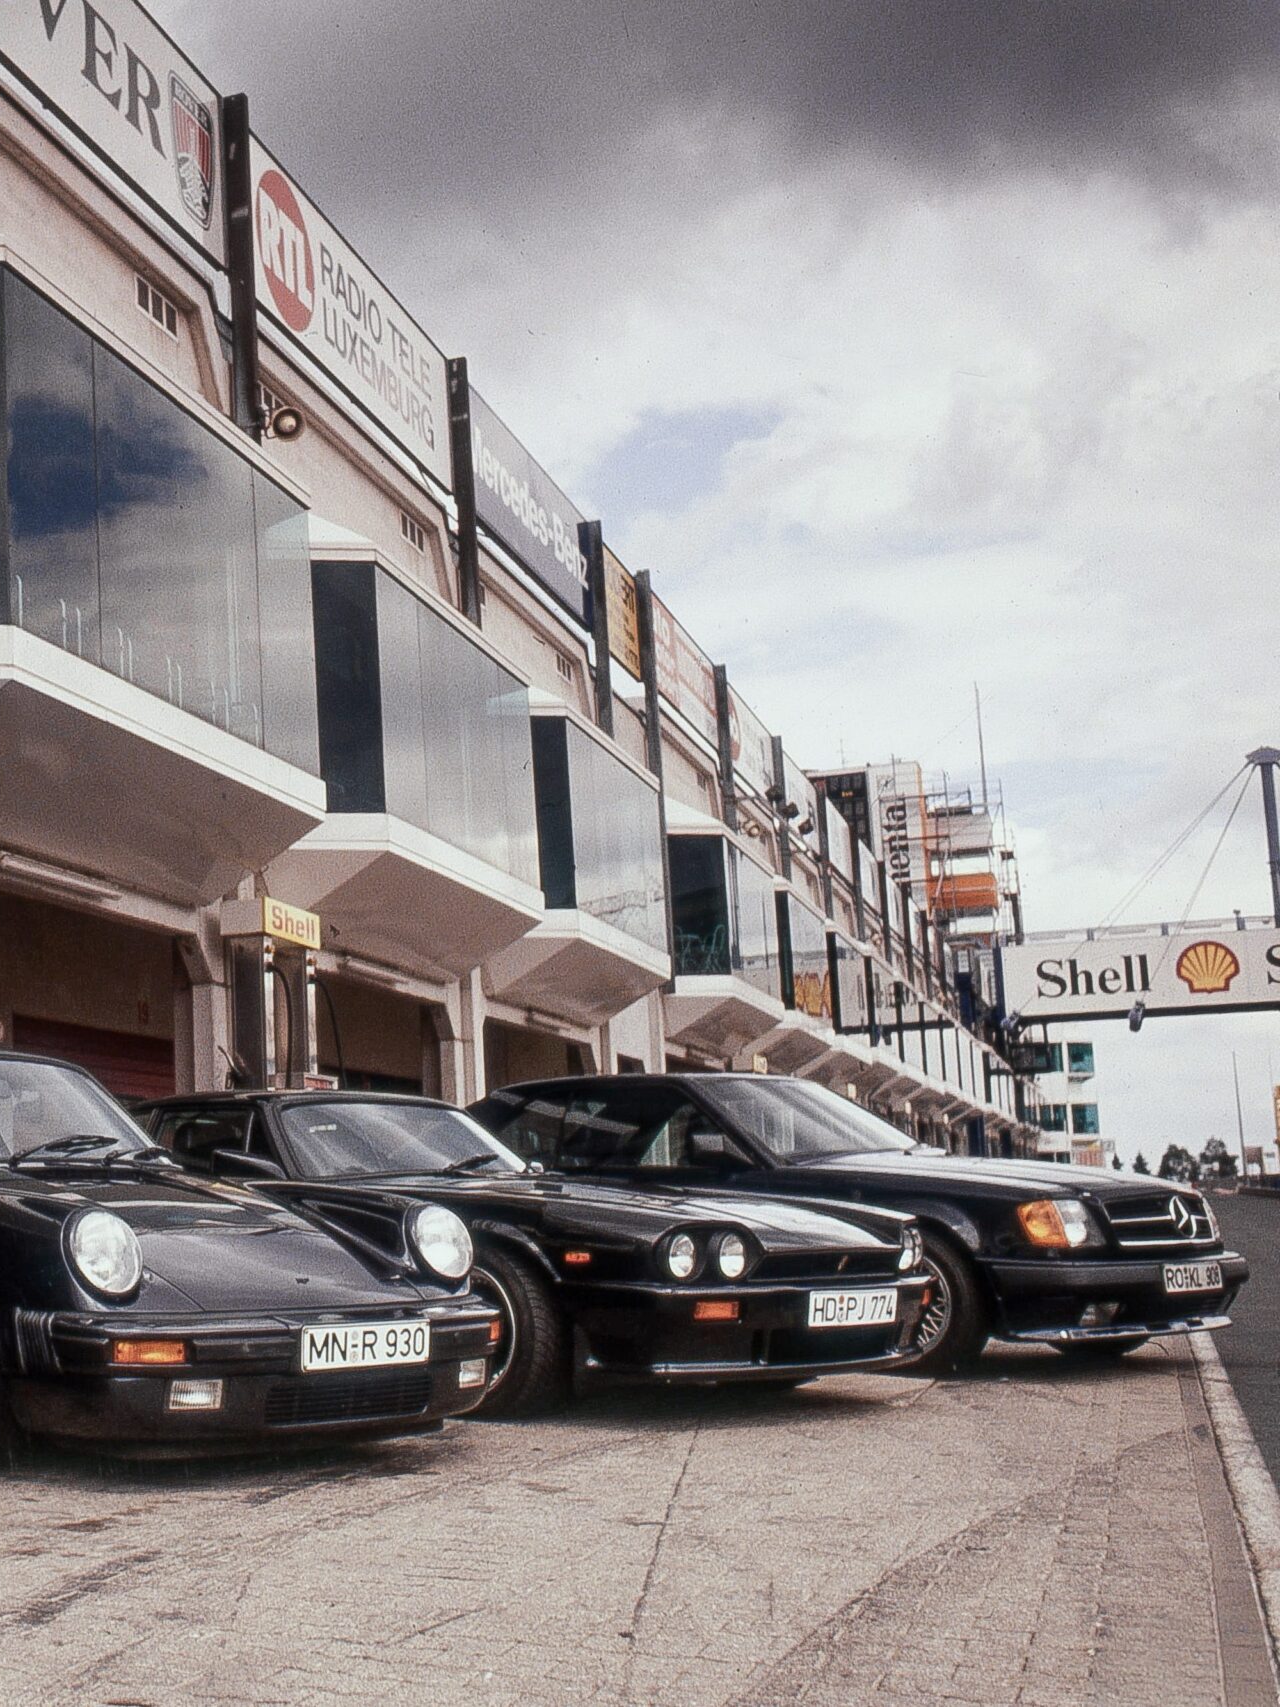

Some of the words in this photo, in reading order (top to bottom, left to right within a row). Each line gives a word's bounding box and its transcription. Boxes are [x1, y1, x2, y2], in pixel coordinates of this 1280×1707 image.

[258, 186, 313, 313] RTL
[320, 241, 382, 345] RADIO
[386, 317, 433, 402] TELE
[322, 297, 435, 452] LUXEMBURG
[470, 425, 589, 591] Mercedes-Benz
[271, 905, 316, 941] Shell
[1036, 954, 1152, 998] Shell
[386, 1327, 425, 1358] 930
[870, 1294, 894, 1320] 774
